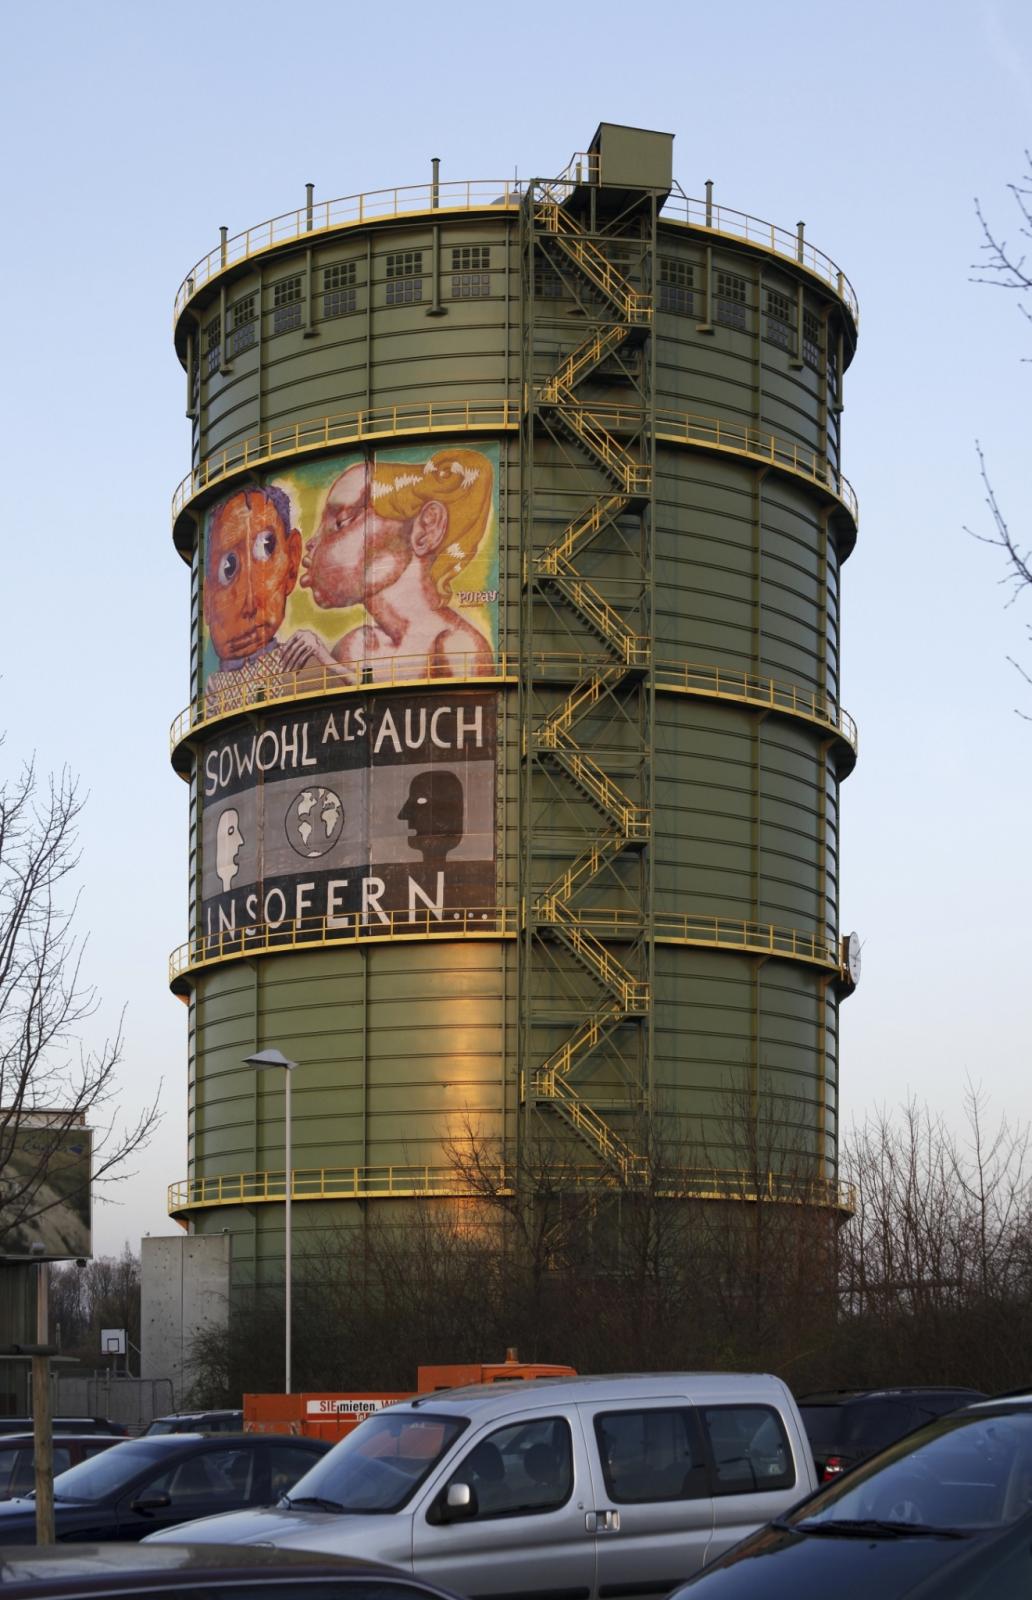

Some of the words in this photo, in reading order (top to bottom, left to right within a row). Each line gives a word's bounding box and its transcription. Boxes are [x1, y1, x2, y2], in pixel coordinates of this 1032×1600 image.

[205, 721, 317, 797] SOWOHL
[321, 705, 367, 744] ALS
[373, 705, 484, 754] AUCH
[319, 1400, 336, 1412] SIE
